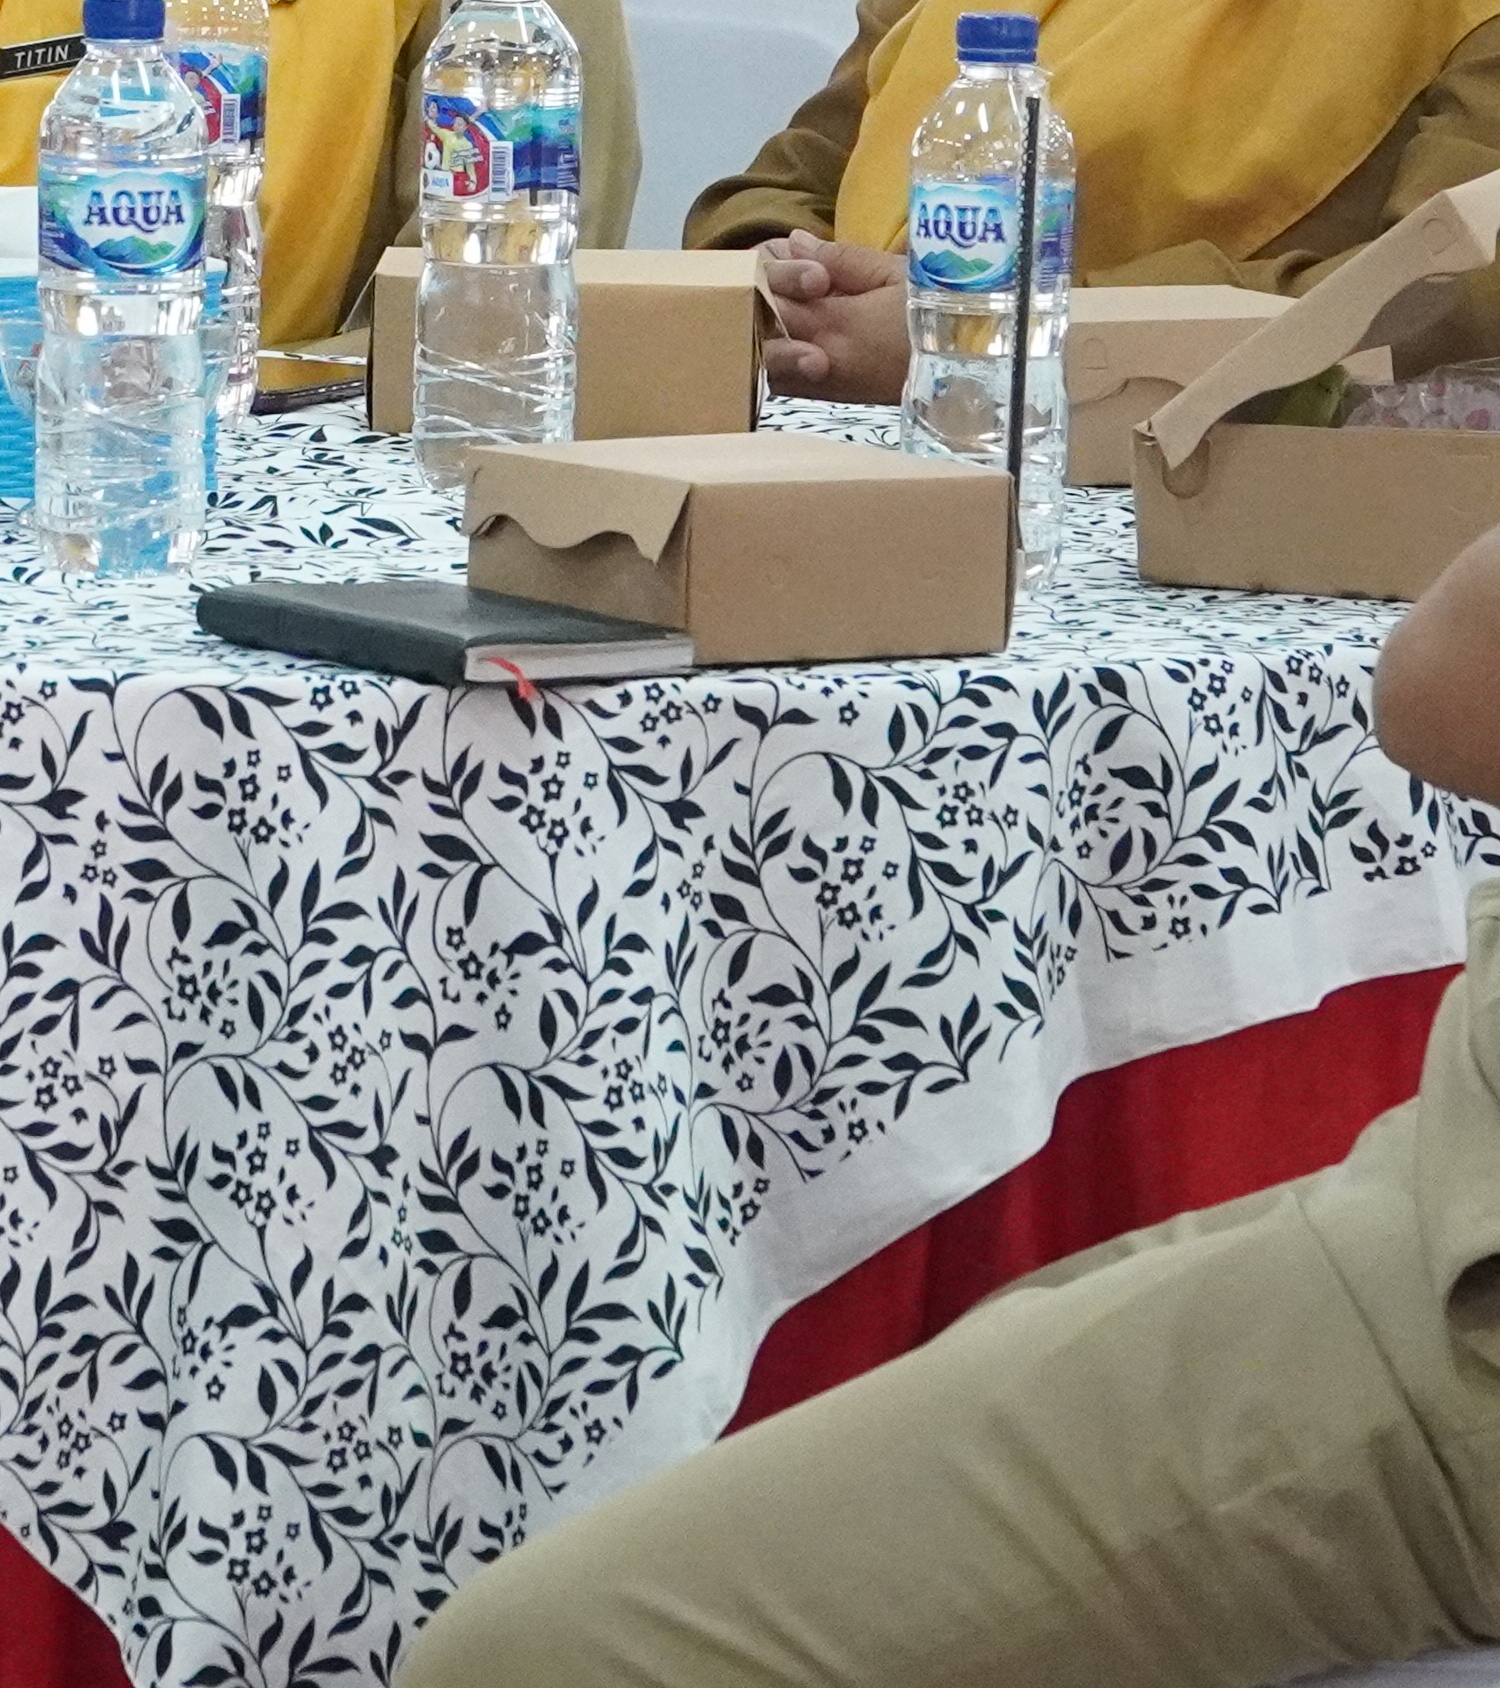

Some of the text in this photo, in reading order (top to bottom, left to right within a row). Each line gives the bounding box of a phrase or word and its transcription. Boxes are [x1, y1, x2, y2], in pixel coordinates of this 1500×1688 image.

[14, 44, 69, 69] TITIN
[84, 189, 185, 233] AQUA
[916, 201, 1007, 249] AQUA
